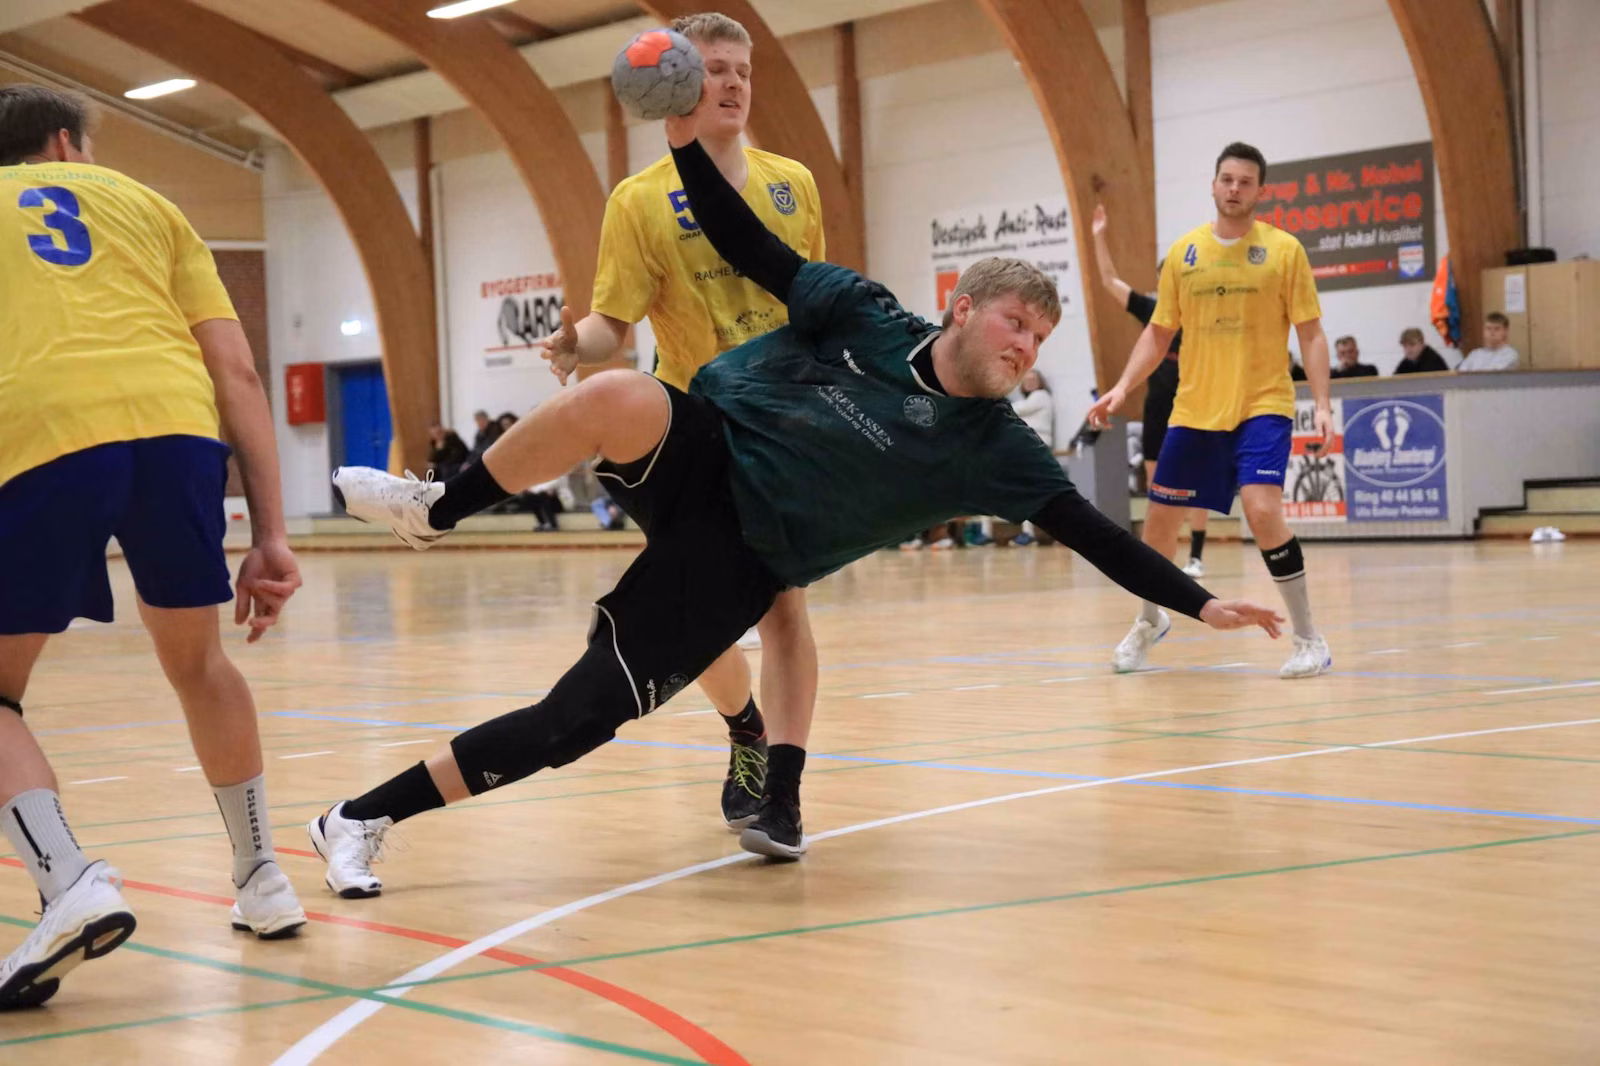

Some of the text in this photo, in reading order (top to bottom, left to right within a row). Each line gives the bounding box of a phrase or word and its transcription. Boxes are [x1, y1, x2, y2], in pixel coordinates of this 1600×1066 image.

[18, 186, 92, 267] 3
[679, 230, 702, 241] CRAF
[1183, 243, 1198, 267] 4
[246, 787, 263, 852] SUPERSOX
